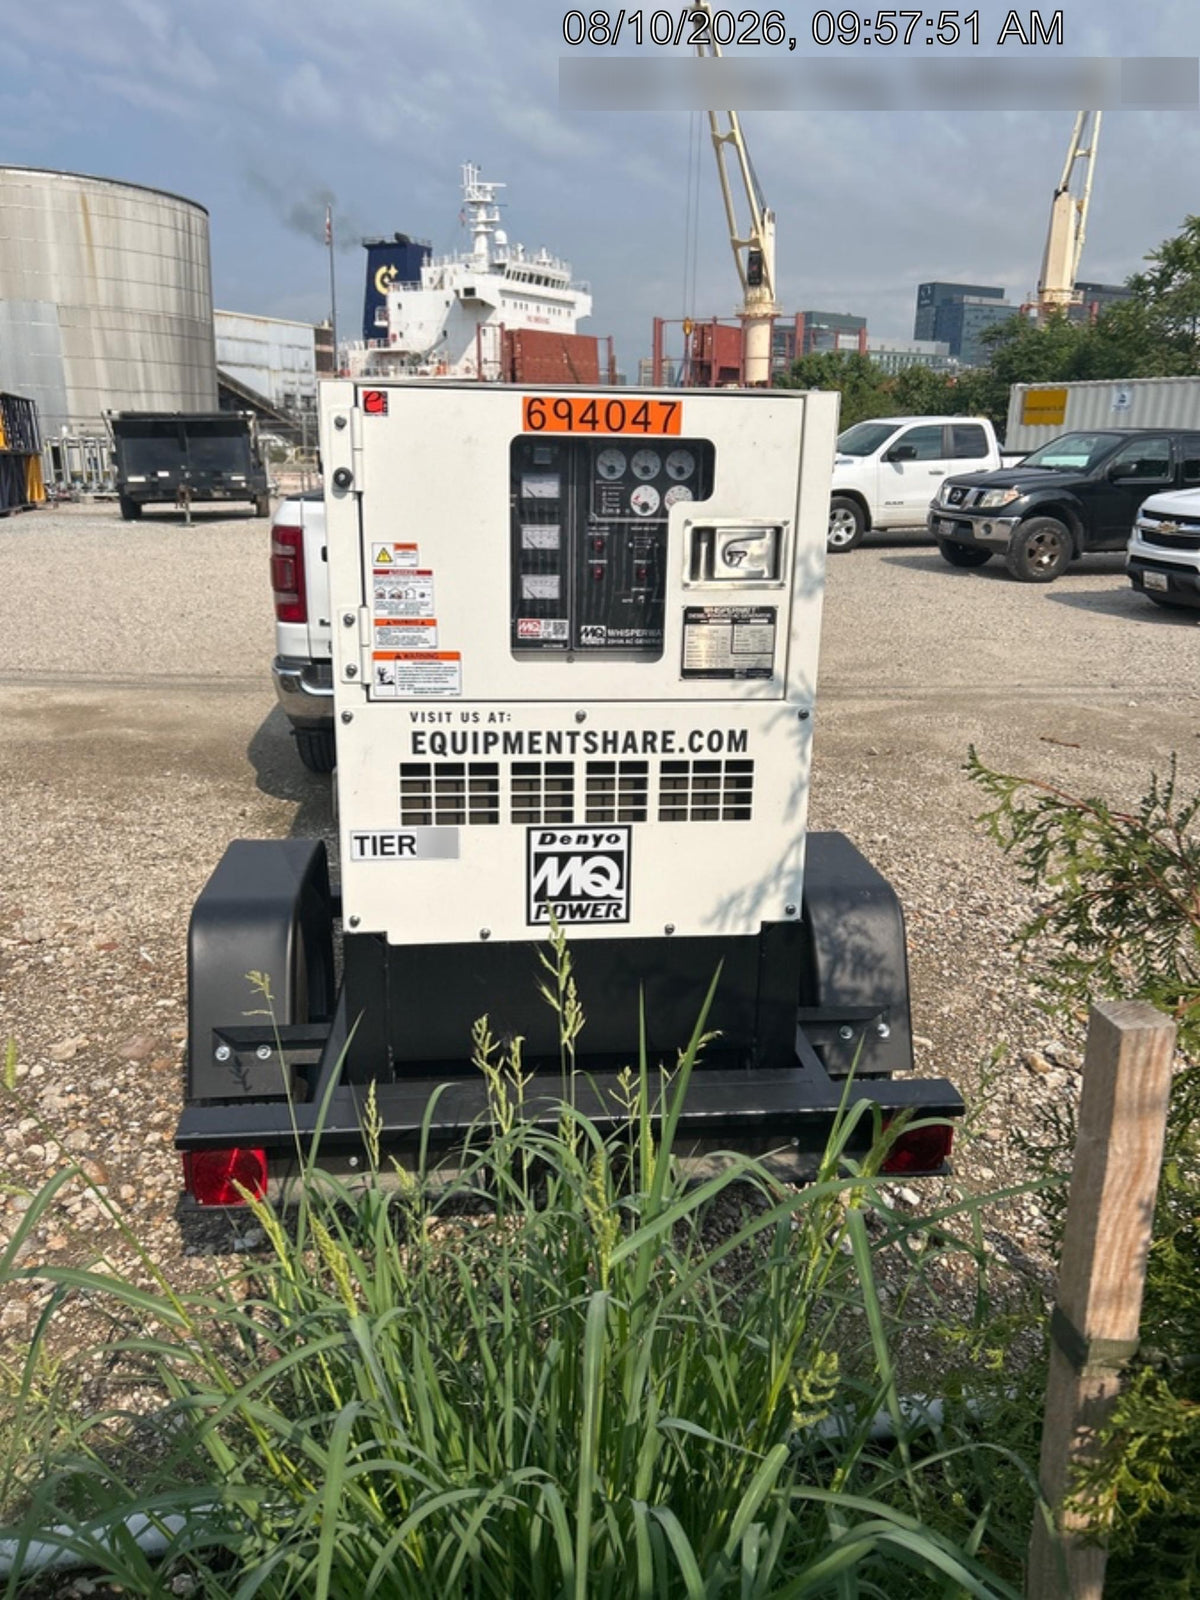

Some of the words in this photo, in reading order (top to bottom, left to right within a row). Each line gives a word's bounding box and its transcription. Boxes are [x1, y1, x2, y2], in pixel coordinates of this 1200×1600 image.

[527, 398, 677, 433] 694047
[581, 625, 606, 638] MQ
[410, 711, 452, 723] VISIT
[460, 711, 480, 723] US
[488, 711, 512, 723] AT:
[411, 729, 748, 757] EQUIPMENTSHARE.COM
[353, 835, 416, 856] TIER
[538, 832, 621, 848] Denyo
[533, 855, 625, 898] MQ
[534, 902, 623, 920] POWER
